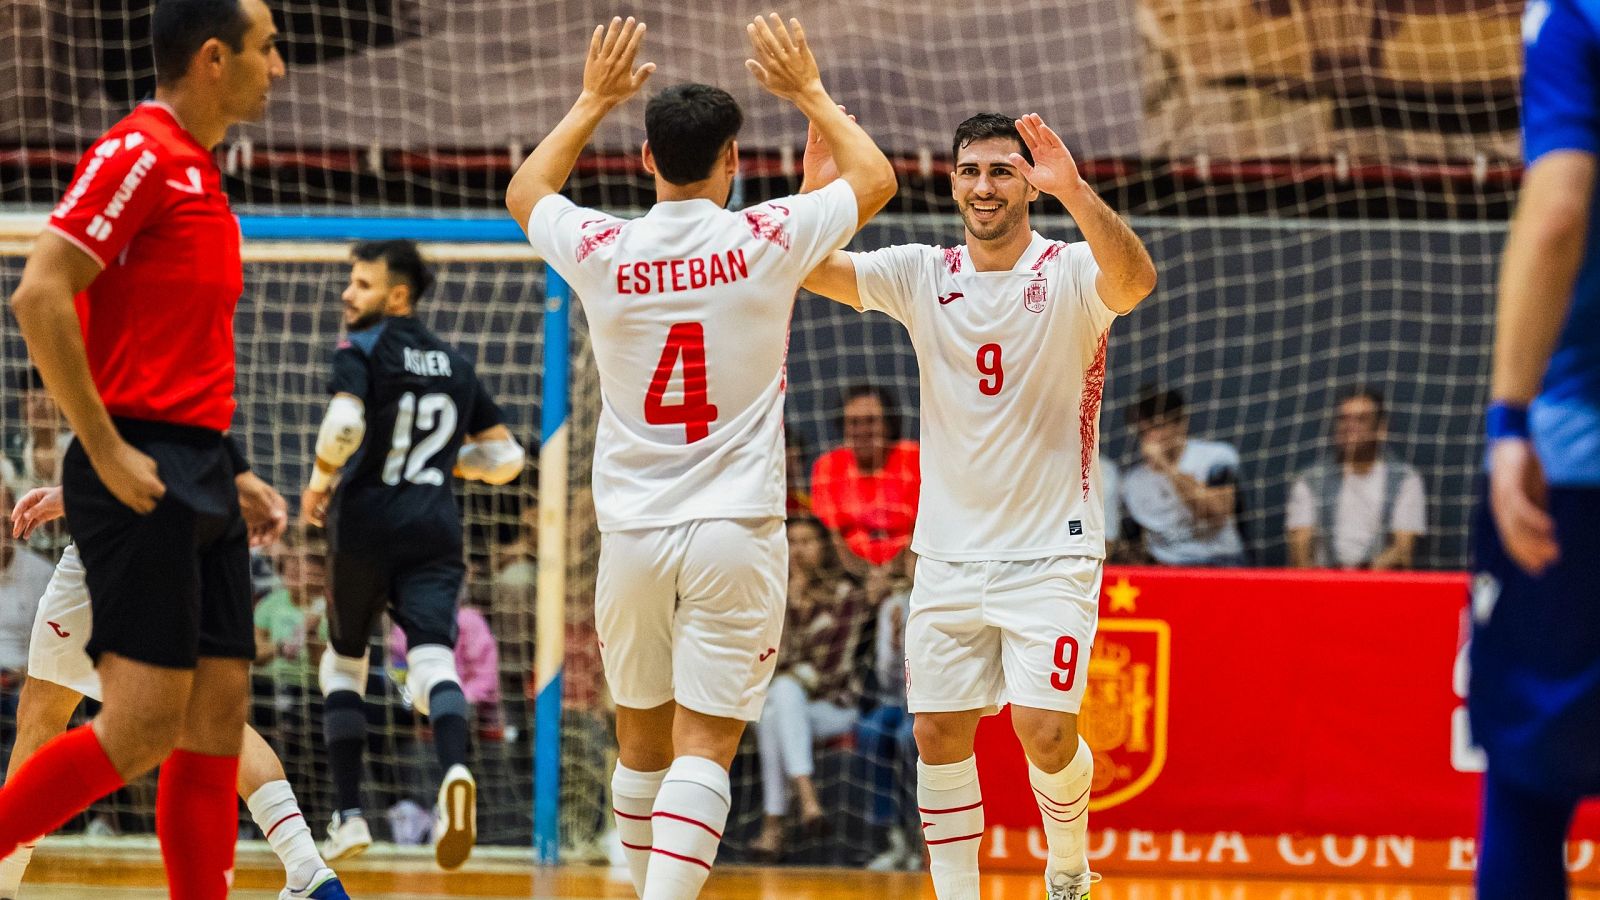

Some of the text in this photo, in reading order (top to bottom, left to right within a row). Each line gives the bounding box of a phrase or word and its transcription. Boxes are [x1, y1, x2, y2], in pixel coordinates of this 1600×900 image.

[617, 248, 748, 295] ESTEBAN
[403, 346, 452, 378] ASIER
[644, 322, 718, 445] 4
[976, 343, 1004, 396] 9
[382, 391, 458, 487] 12
[1050, 635, 1079, 692] 9
[1277, 833, 1414, 868] CON
